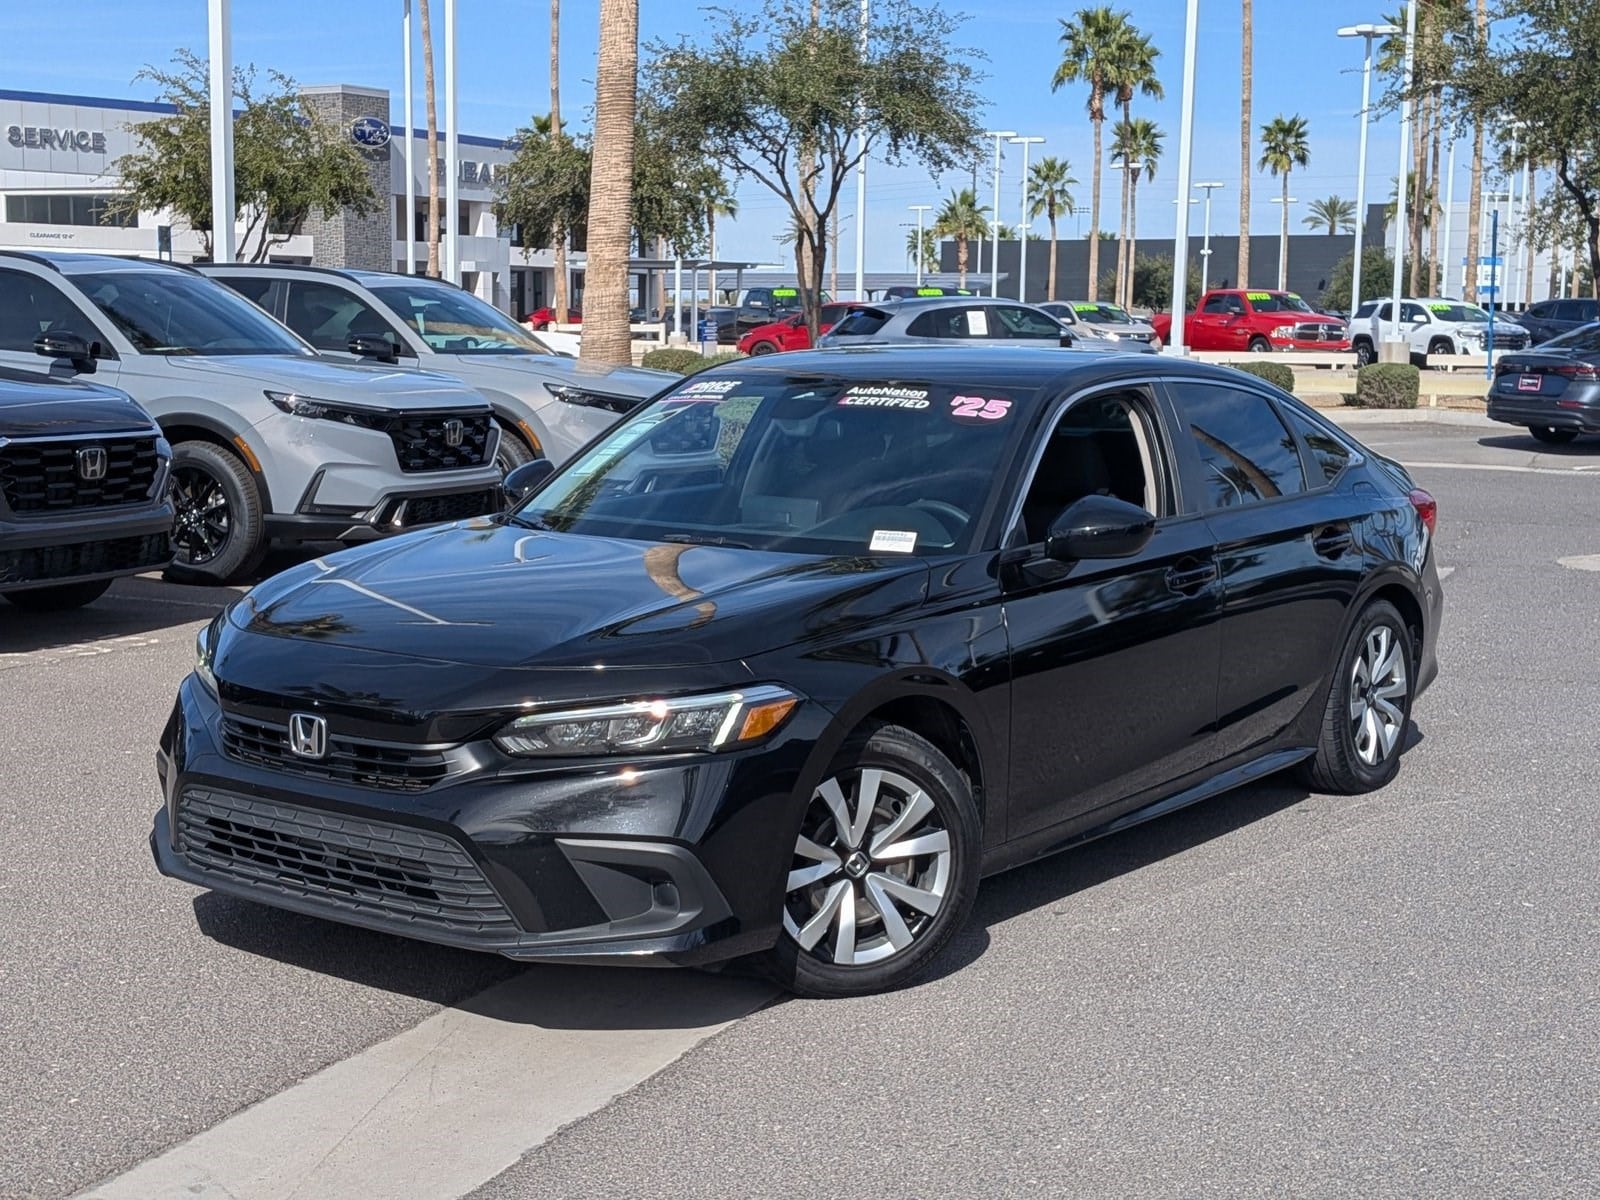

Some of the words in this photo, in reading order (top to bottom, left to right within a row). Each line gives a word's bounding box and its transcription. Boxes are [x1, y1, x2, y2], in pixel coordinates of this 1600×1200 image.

[8, 126, 106, 153] SERVICE
[847, 386, 928, 399] AutoNation
[845, 396, 930, 409] CERTIFIED
[950, 395, 1012, 420] '25
